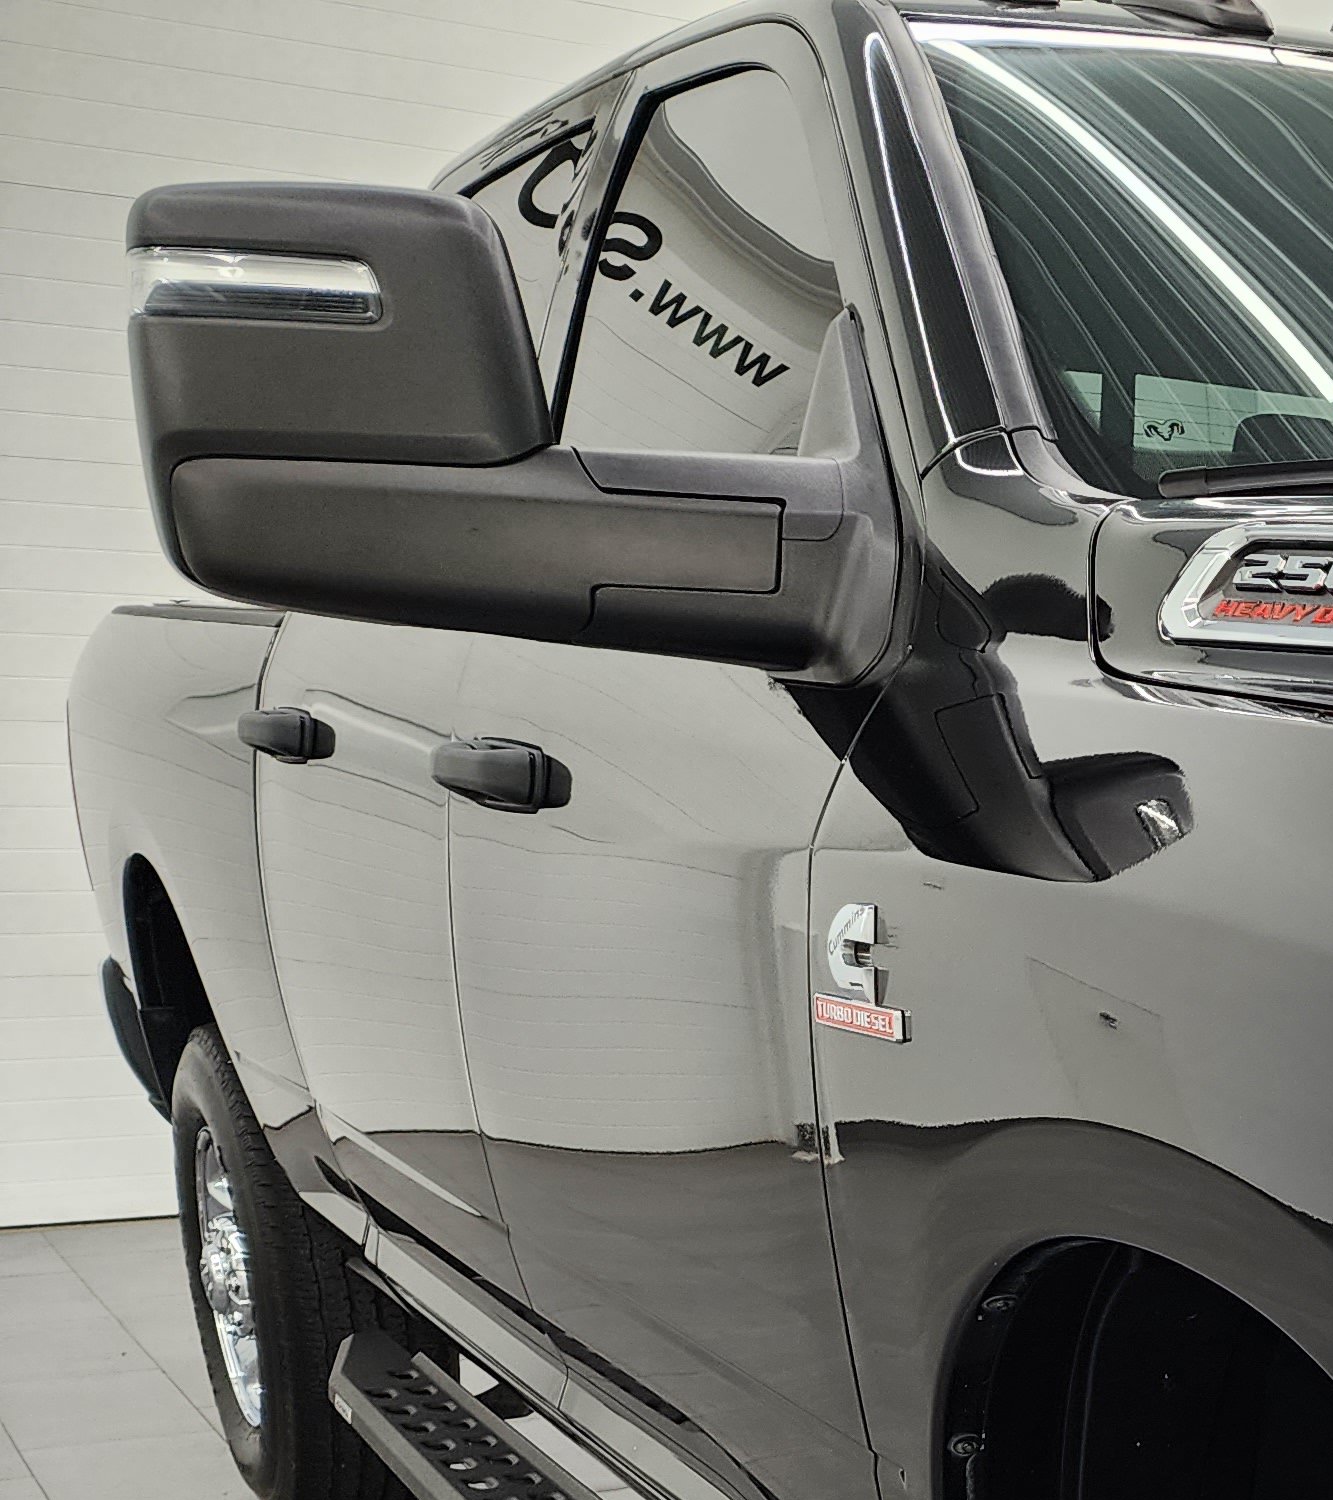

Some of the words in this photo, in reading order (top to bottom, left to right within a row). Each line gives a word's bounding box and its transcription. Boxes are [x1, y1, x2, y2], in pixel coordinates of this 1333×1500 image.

[1213, 600, 1314, 622] HEAVY
[828, 906, 865, 956] Cummins
[816, 1000, 852, 1024] TURBO
[853, 1008, 894, 1035] DIESEL
